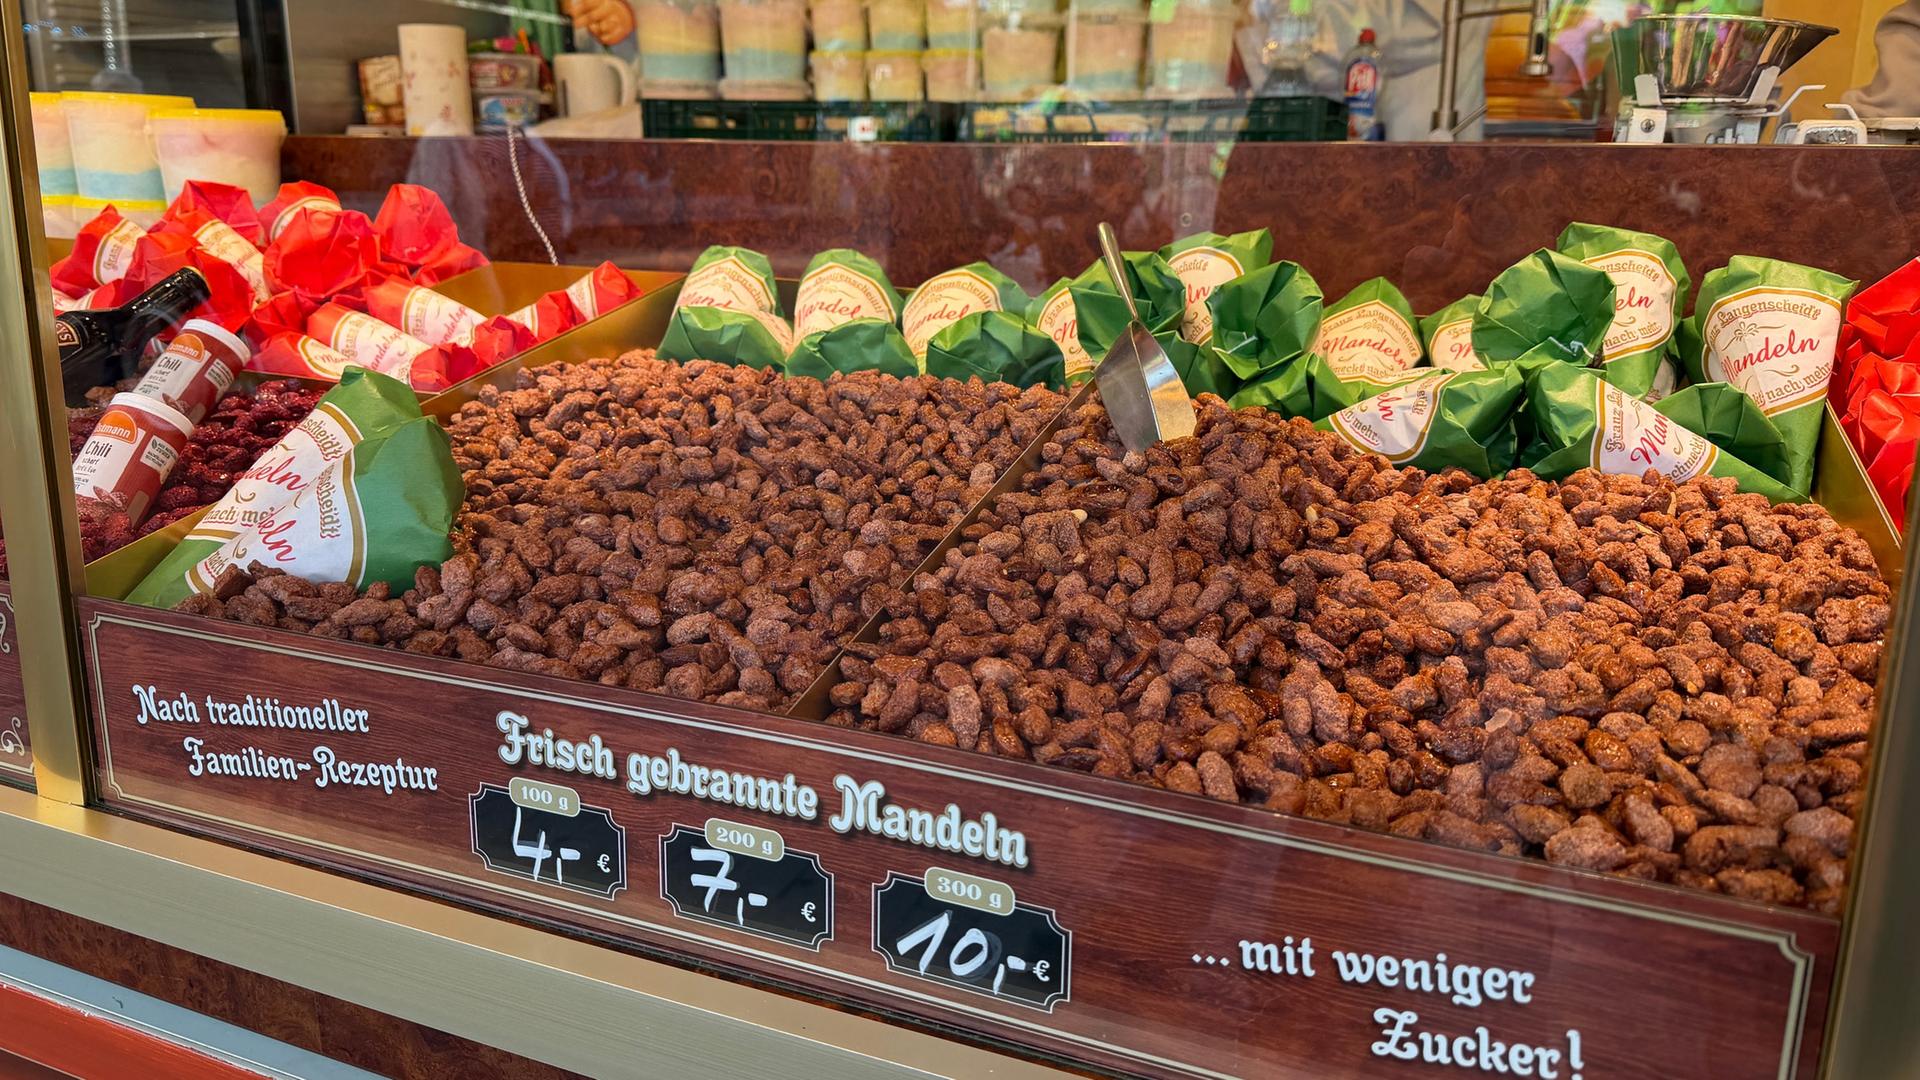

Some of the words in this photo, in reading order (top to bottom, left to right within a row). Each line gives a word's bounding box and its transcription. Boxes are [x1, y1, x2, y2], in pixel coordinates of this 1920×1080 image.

[158, 356, 183, 372] Chili
[1765, 379, 1804, 402] nach
[85, 440, 113, 458] Chili
[131, 684, 201, 725] Nach
[205, 694, 370, 733] traditioneller
[183, 736, 438, 795] Familien-Rezeptur
[495, 710, 617, 780] Frisch
[626, 748, 818, 821] gebrannte
[828, 774, 1029, 868] Mandeln
[520, 785, 553, 805] 100
[558, 796, 568, 810] g
[716, 826, 756, 848] 200
[761, 840, 773, 855] g
[596, 853, 612, 873] €
[937, 876, 982, 900] 300
[988, 893, 1002, 908] g
[800, 901, 817, 923] €
[1032, 959, 1050, 982] €
[1331, 953, 1536, 1007] weniger
